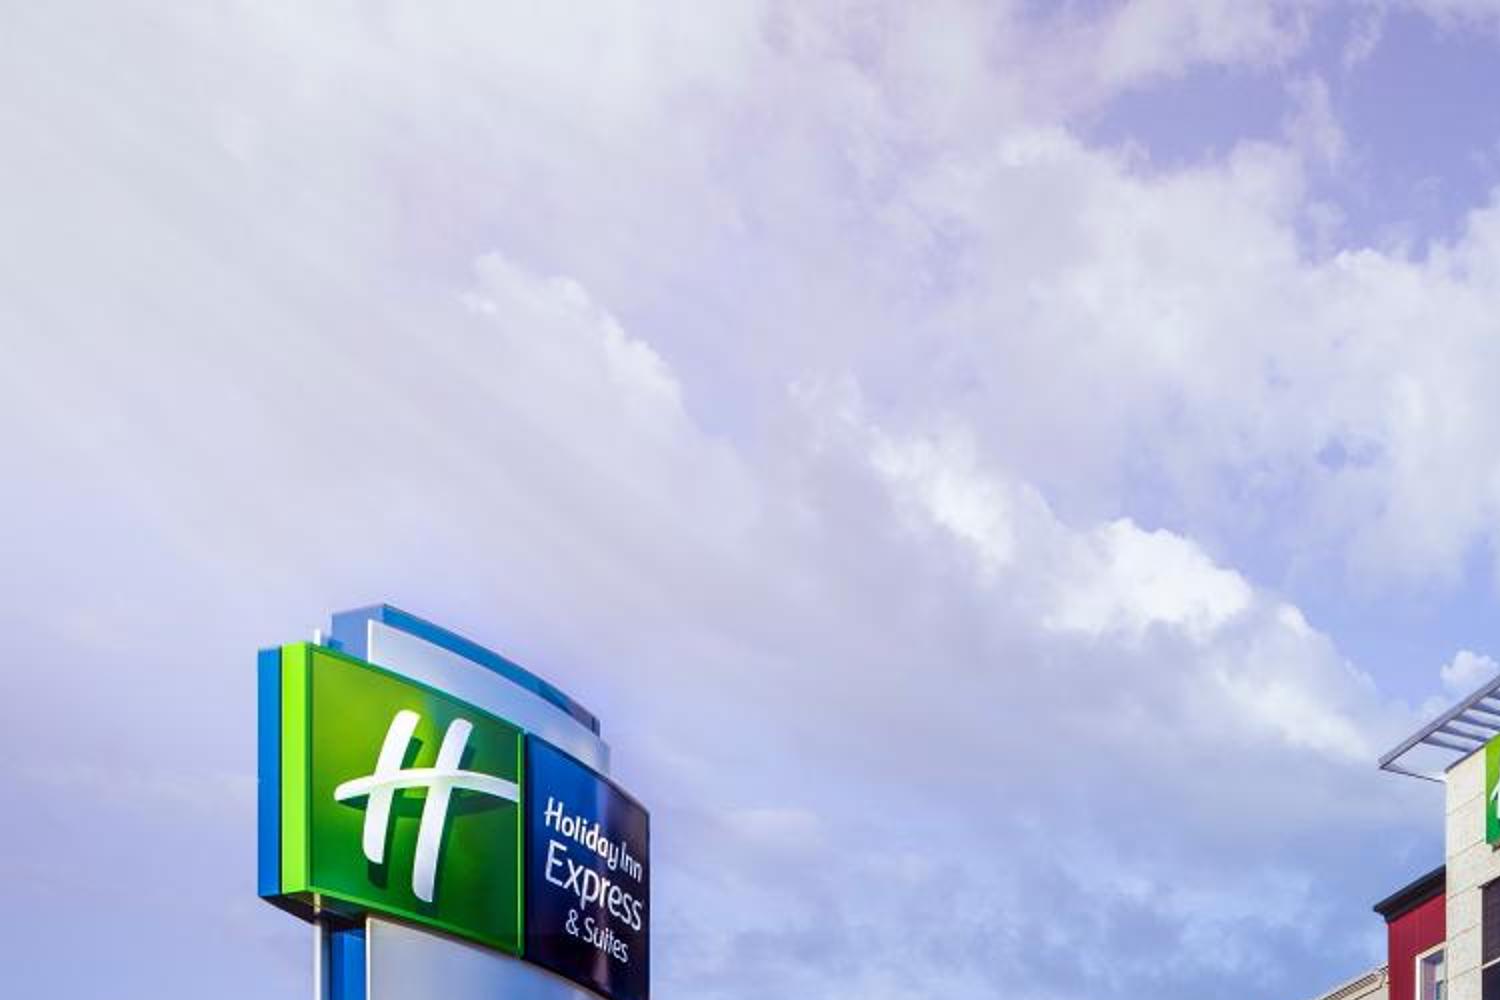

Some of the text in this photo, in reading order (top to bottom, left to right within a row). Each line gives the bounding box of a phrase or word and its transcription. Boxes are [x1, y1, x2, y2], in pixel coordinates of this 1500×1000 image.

[544, 796, 643, 883] Holiday Inn
[545, 839, 643, 931] Express
[565, 909, 629, 963] & Suites
